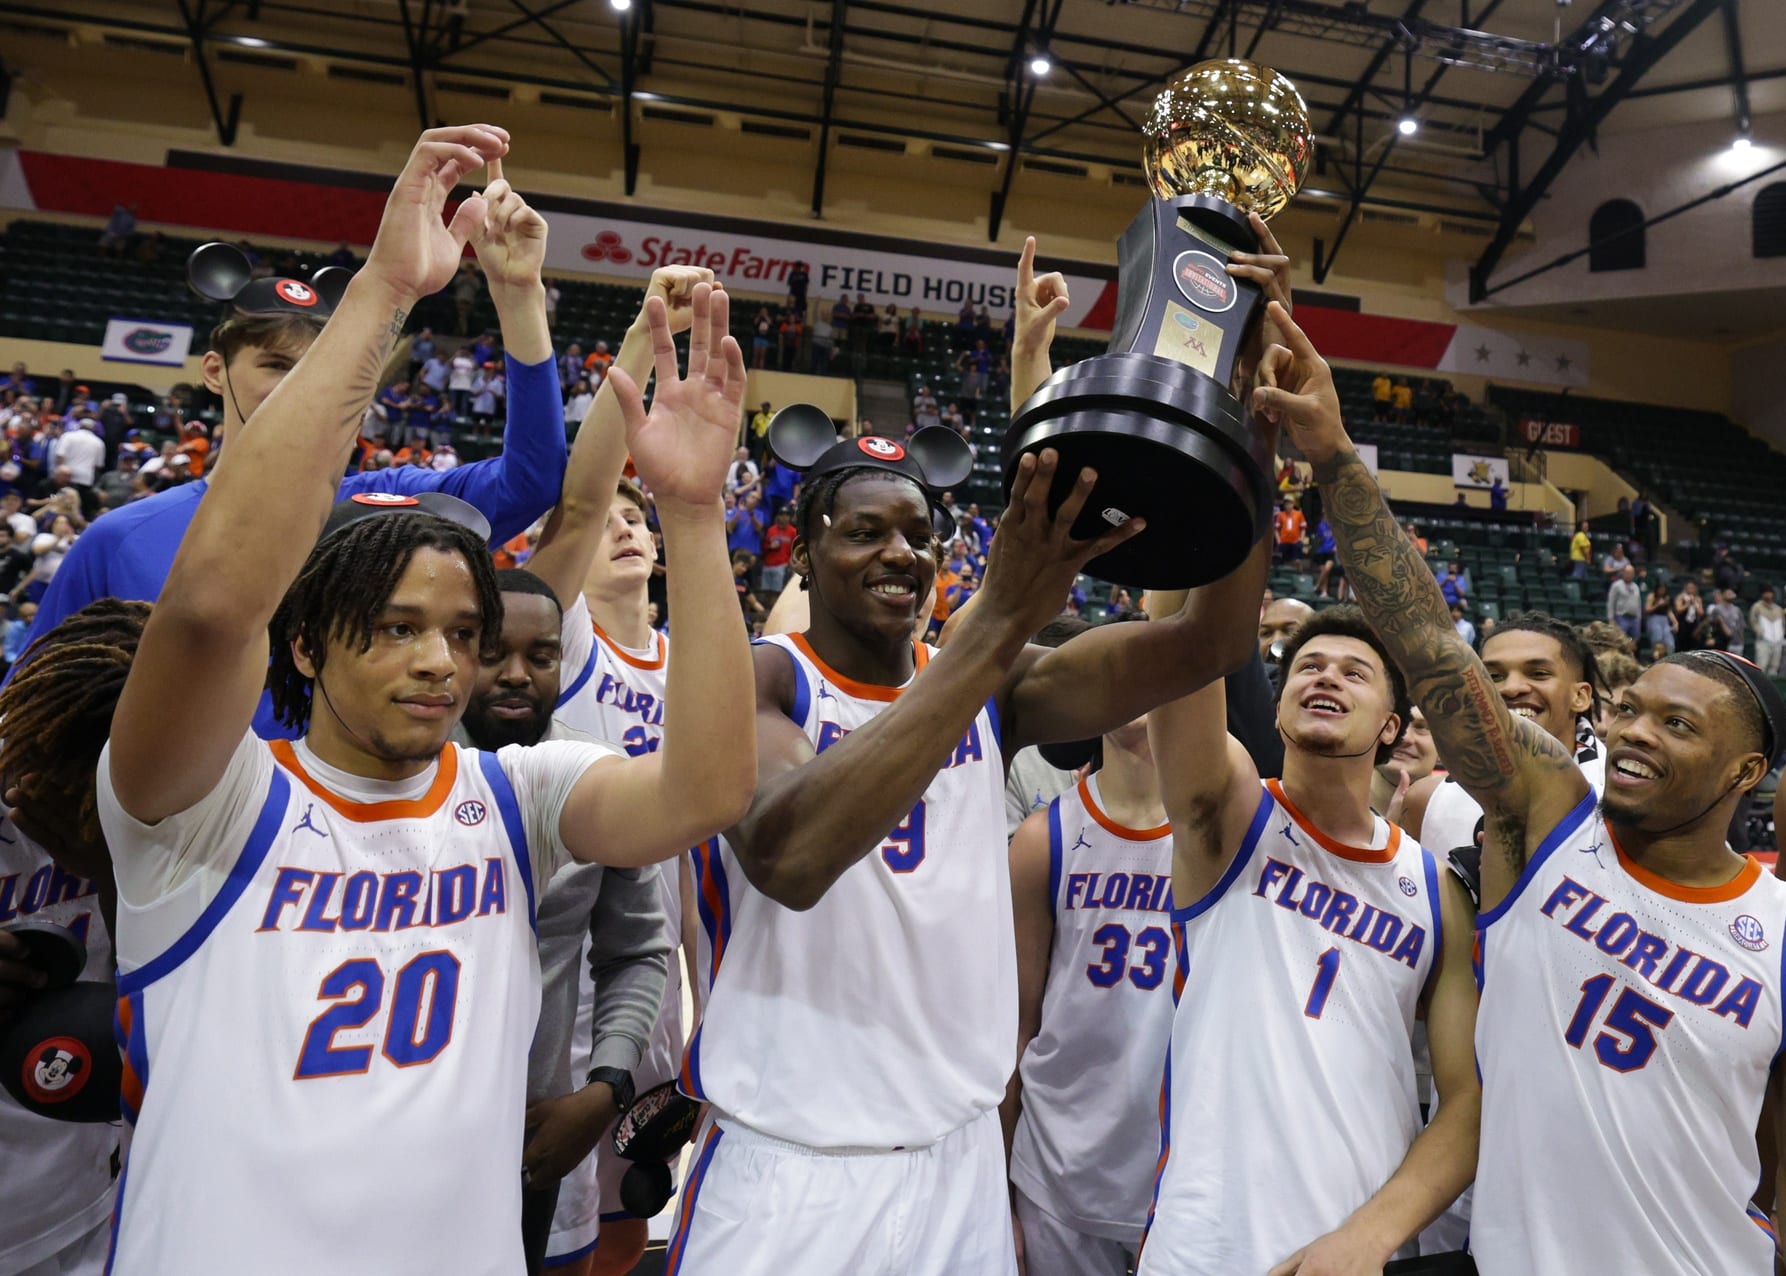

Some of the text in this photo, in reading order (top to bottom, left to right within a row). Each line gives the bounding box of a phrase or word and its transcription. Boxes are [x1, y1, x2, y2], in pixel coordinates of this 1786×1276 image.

[821, 264, 912, 296] FIELD
[457, 802, 484, 825] SEC
[254, 857, 507, 933] FLORIDA
[1252, 856, 1427, 969] FLORIDA
[1737, 916, 1763, 941] SEC
[1086, 923, 1171, 991] 33
[1304, 947, 1341, 1019] 1
[1540, 875, 1763, 1029] FLORIDA
[293, 949, 461, 1080] 20
[1565, 973, 1674, 1073] 15
